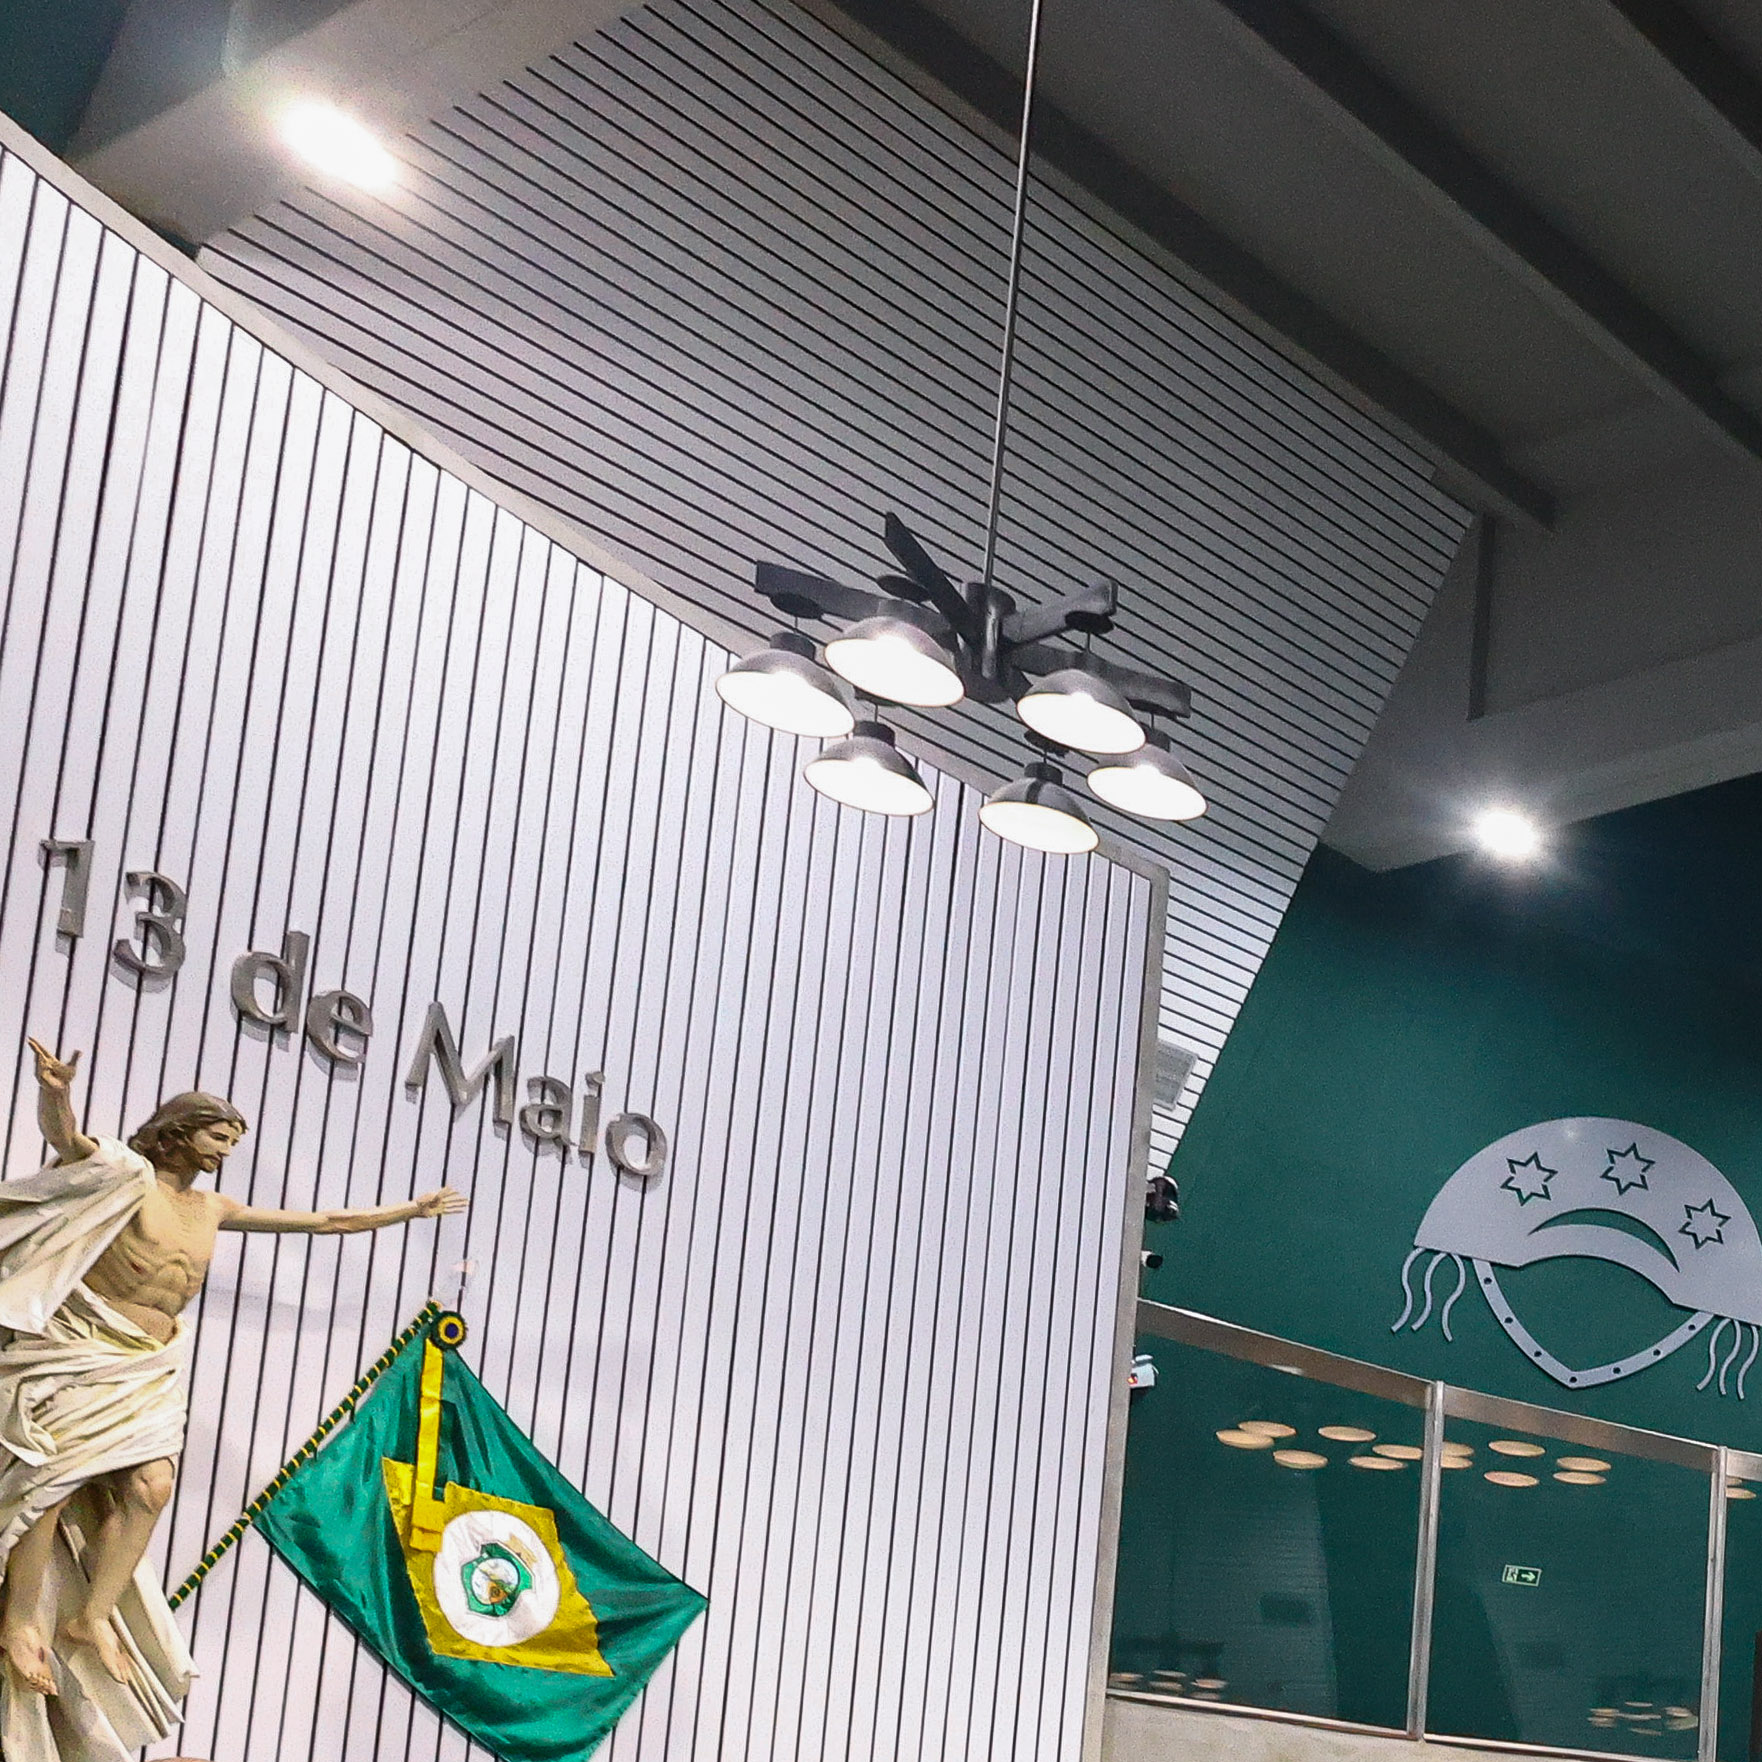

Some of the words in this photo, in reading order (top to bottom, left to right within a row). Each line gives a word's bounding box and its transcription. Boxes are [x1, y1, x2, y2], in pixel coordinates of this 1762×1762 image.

[40, 838, 188, 978] 13
[231, 930, 373, 1064] de
[404, 1000, 668, 1177] Maio
